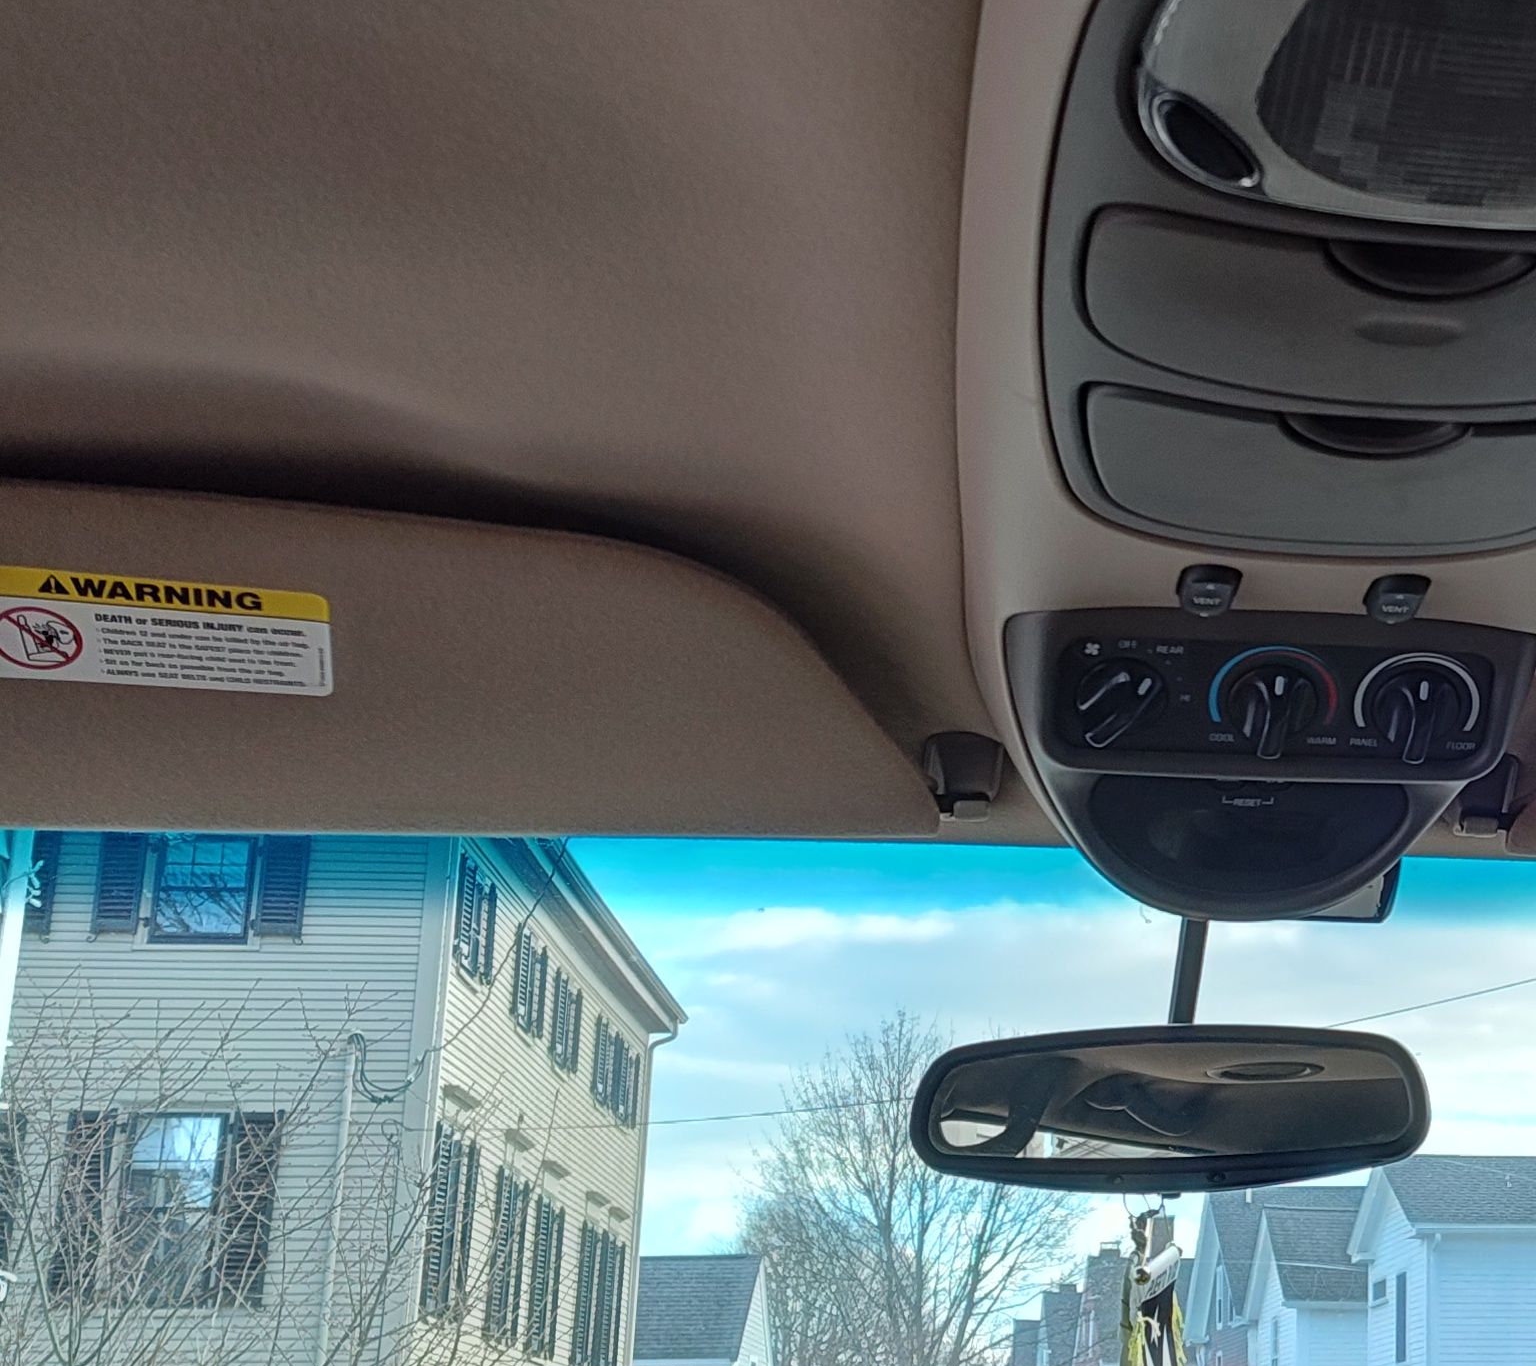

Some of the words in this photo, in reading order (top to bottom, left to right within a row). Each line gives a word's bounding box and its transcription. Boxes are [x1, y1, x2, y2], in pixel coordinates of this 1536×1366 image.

[70, 577, 262, 611] WARNING
[1193, 596, 1221, 605] VENT
[1382, 605, 1409, 614] VENT
[94, 613, 132, 624] DEATH
[150, 618, 199, 629] SERIOUS
[202, 622, 243, 632] INJURY
[1156, 645, 1184, 654] REAR
[1208, 733, 1235, 743] COOL
[1307, 737, 1337, 746] WARM
[1350, 737, 1378, 748] PANEL
[1446, 742, 1476, 752] FLOOR
[1232, 798, 1261, 807] RESET
